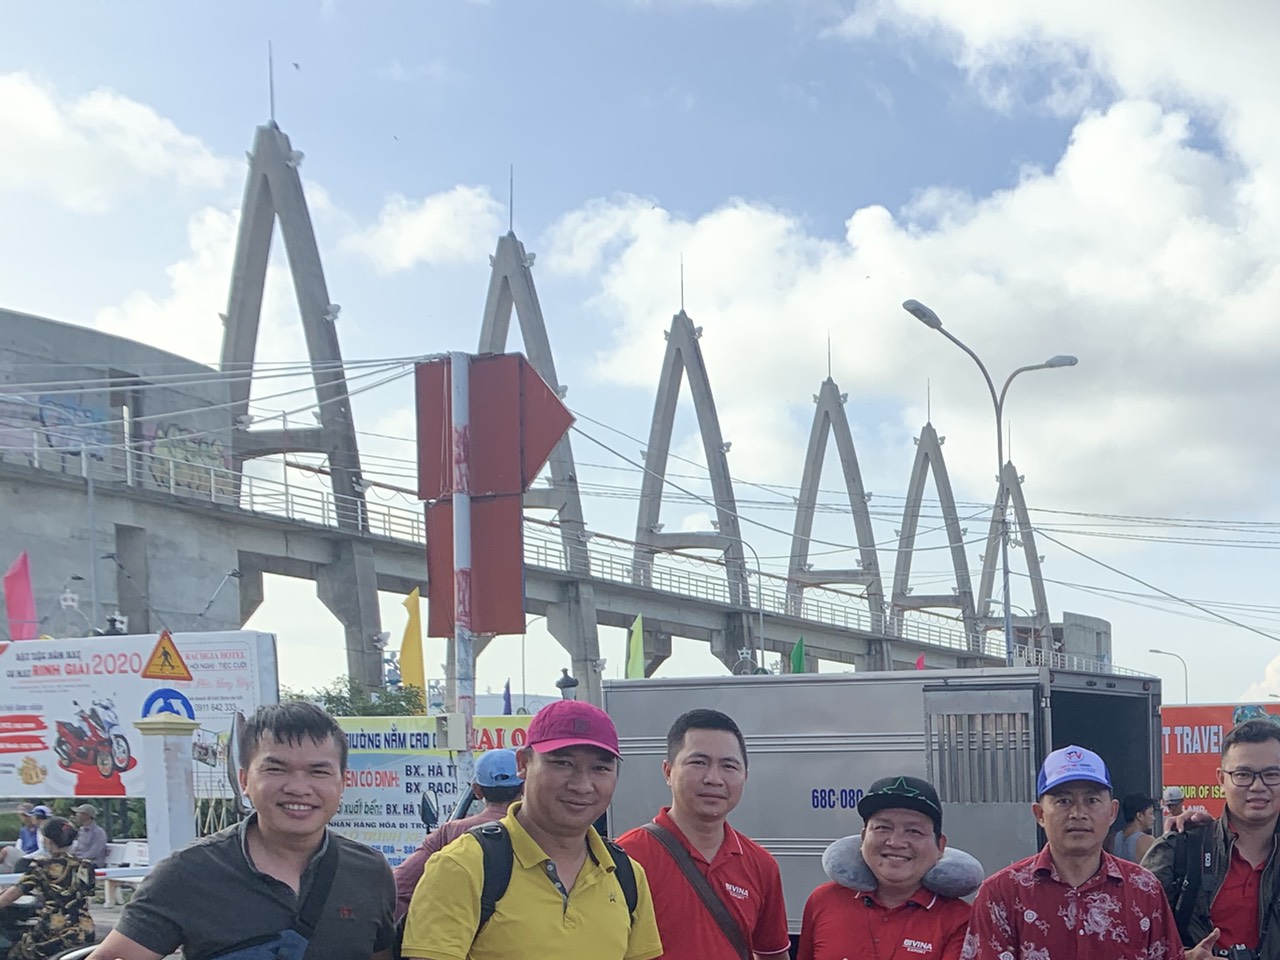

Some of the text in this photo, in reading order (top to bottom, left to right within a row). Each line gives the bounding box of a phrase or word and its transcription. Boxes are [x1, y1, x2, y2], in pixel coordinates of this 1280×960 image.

[92, 652, 142, 675] 2020
[410, 732, 429, 748] CAO
[405, 764, 424, 777] BX.
[903, 939, 933, 950] BIVINA
